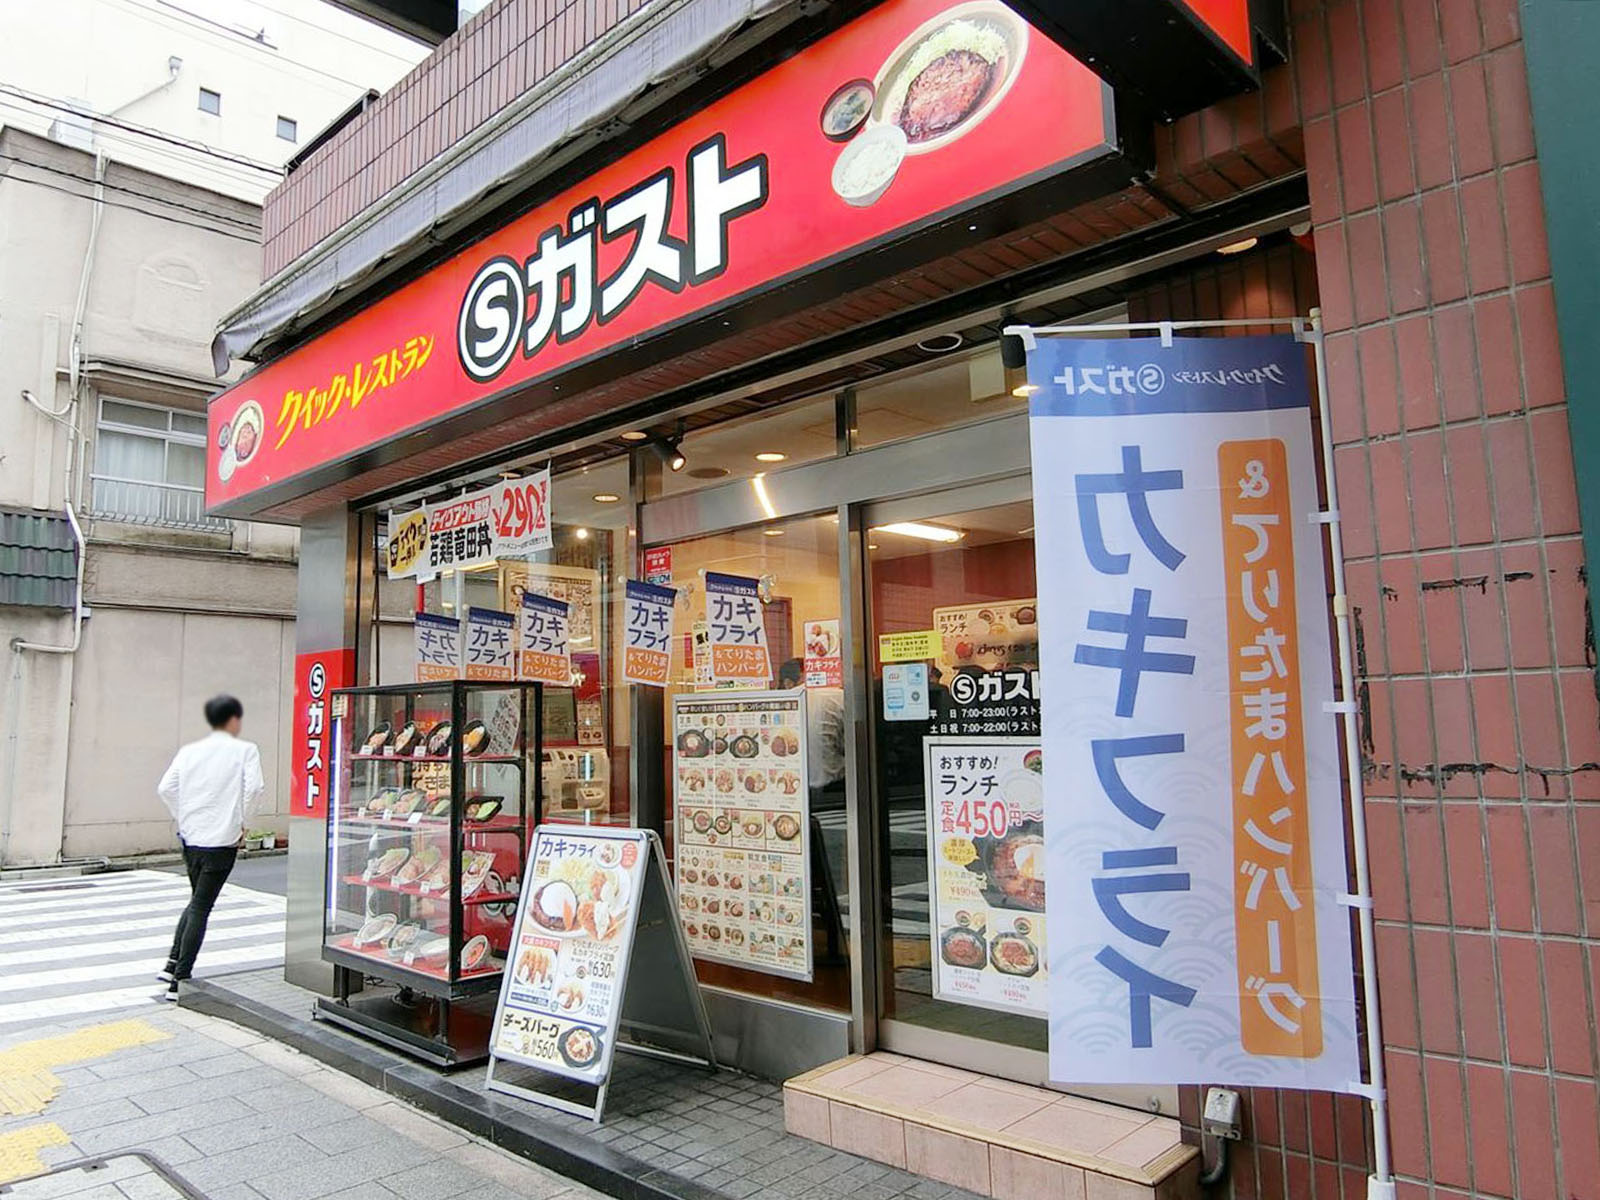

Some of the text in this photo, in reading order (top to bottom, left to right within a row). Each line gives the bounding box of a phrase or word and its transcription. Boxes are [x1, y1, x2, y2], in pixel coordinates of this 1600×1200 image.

[631, 602, 669, 631] カキ
[713, 596, 756, 623] カキ
[527, 612, 563, 637] カキ
[712, 624, 761, 644] フライ
[472, 626, 509, 649] カキ
[524, 634, 566, 654] フライ
[628, 628, 670, 651] フライ
[468, 648, 510, 665] フライ
[961, 706, 1041, 718] 7:00-23:00(ラスト
[962, 721, 1041, 733] 7:00-22:00(ラスト
[940, 756, 998, 770] おすすめ!
[940, 775, 998, 796] ランチ
[540, 838, 597, 858] カキフライ
[503, 1013, 561, 1038] チーズバーグ
